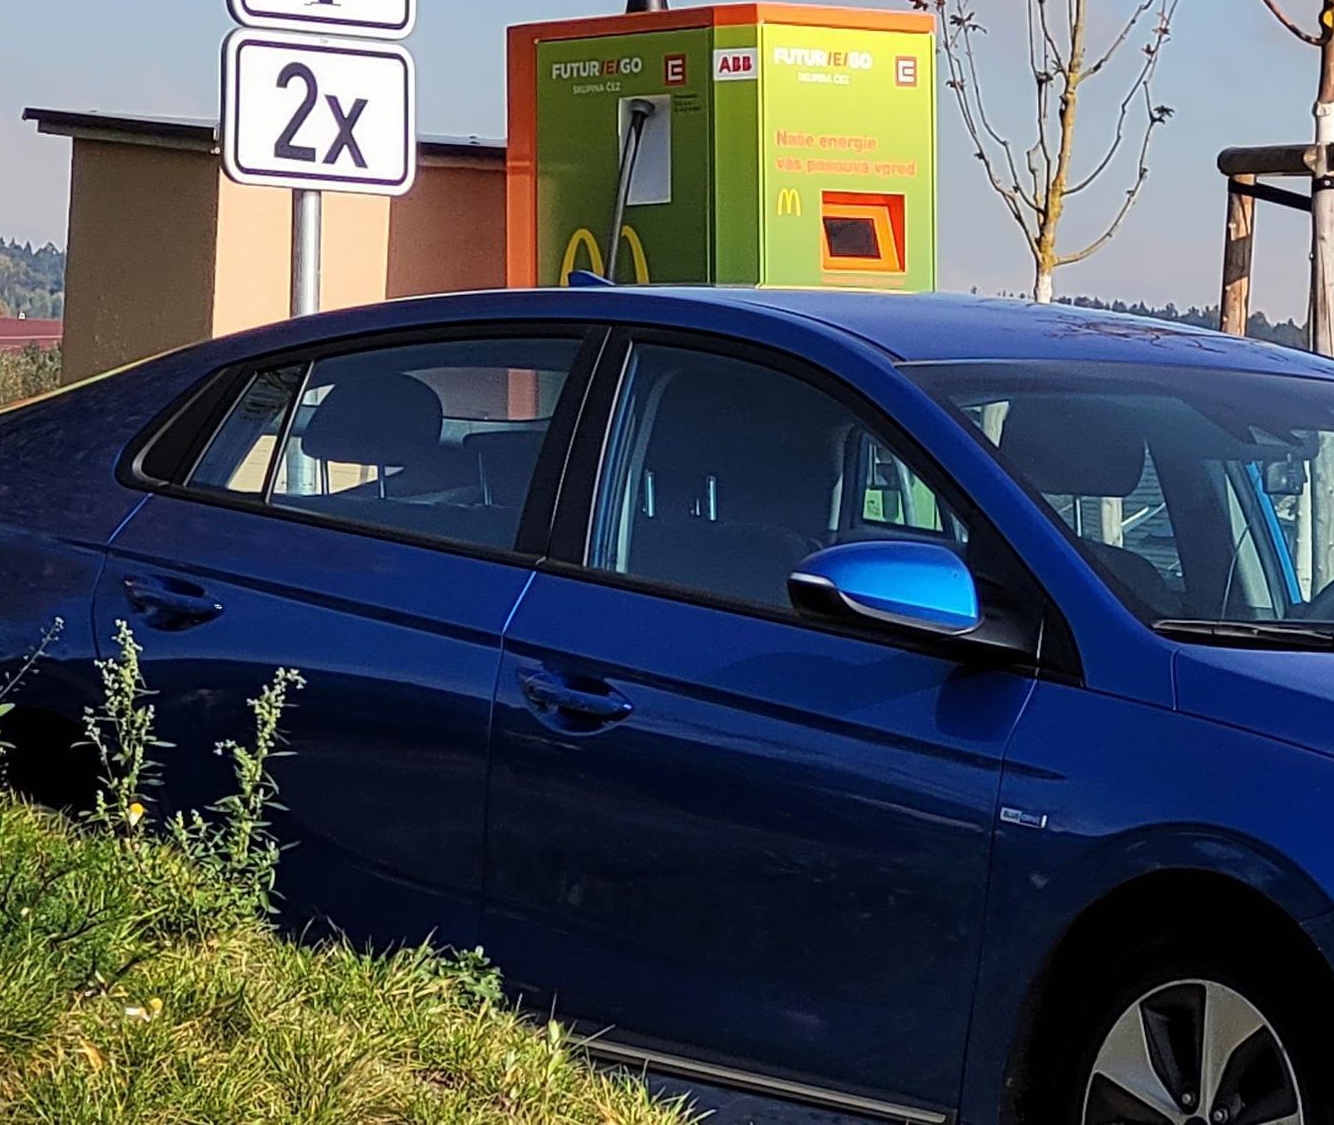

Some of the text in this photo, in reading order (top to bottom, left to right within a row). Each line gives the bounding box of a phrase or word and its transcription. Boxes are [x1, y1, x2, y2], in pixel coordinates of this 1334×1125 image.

[551, 57, 643, 80] FUTUR/E/GO
[719, 55, 753, 74] ABB
[273, 61, 369, 169] 2x
[819, 135, 877, 154] energie
